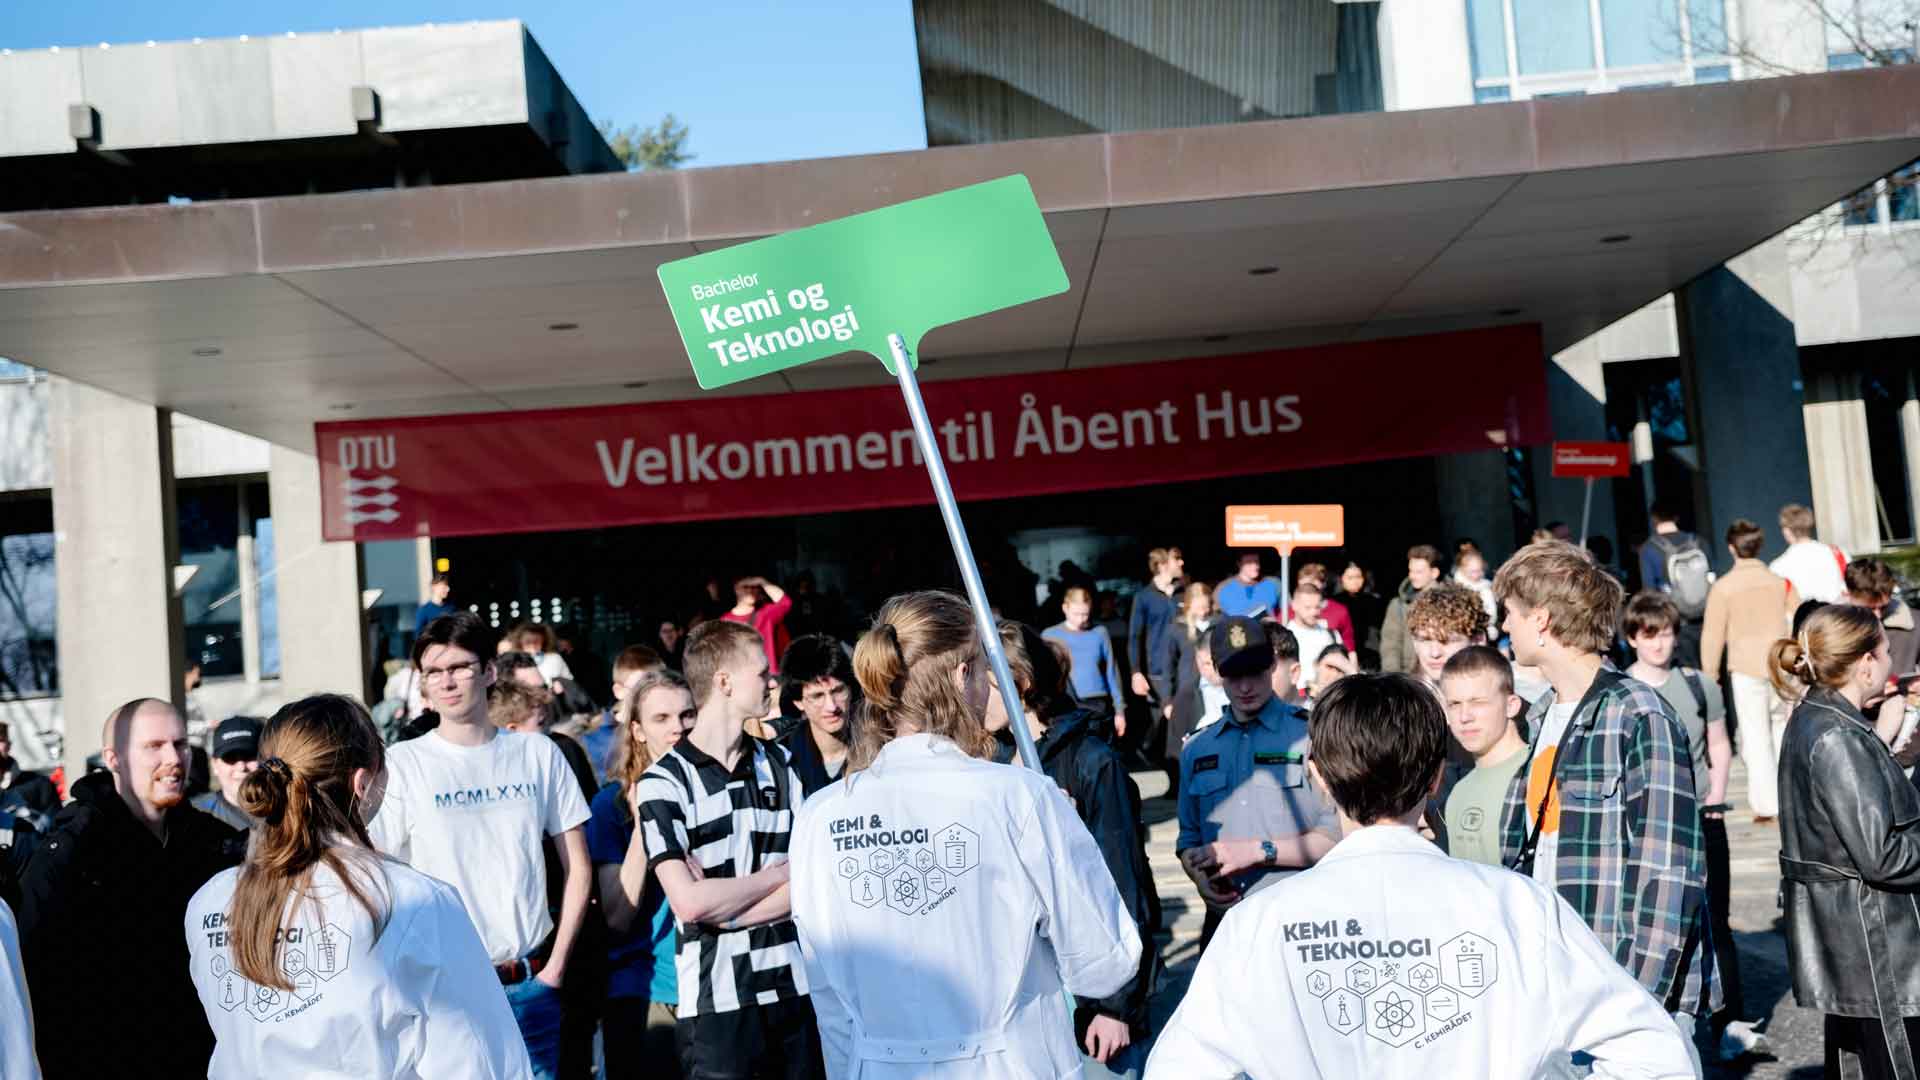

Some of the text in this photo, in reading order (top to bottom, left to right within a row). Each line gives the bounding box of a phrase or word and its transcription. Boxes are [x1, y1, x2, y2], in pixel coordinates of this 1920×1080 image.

[690, 272, 759, 301] Bachelor
[700, 282, 830, 334] Kemi og
[707, 304, 860, 368] Teknologi
[338, 434, 397, 472] DTU
[595, 390, 1303, 489] Velkommen til Åbent Hus
[869, 814, 883, 830] &
[833, 828, 929, 852] TEKNOLOGI
[1283, 918, 1363, 942] KEMI &
[1297, 938, 1432, 964] TEKNOLOGI
[1424, 1010, 1474, 1045] KEMIRÅDET
